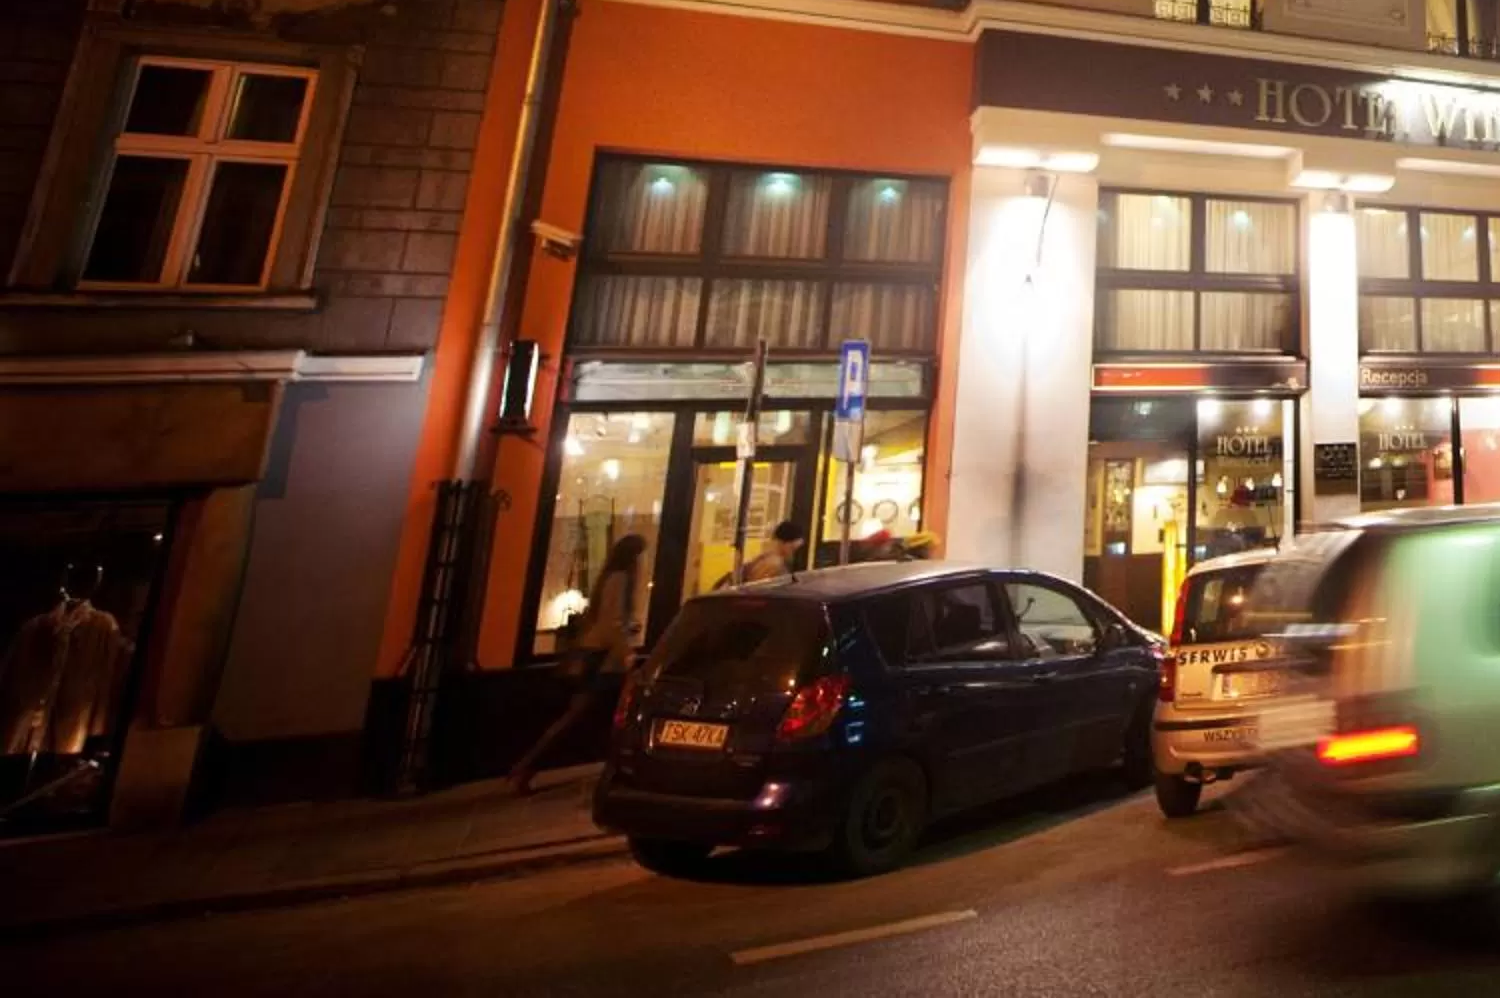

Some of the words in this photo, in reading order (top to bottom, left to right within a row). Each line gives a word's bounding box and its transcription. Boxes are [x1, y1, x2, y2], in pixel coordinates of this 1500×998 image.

[1255, 78, 1411, 133] HOTE
[1361, 369, 1428, 388] Recepcja
[1178, 646, 1248, 665] SERWIS
